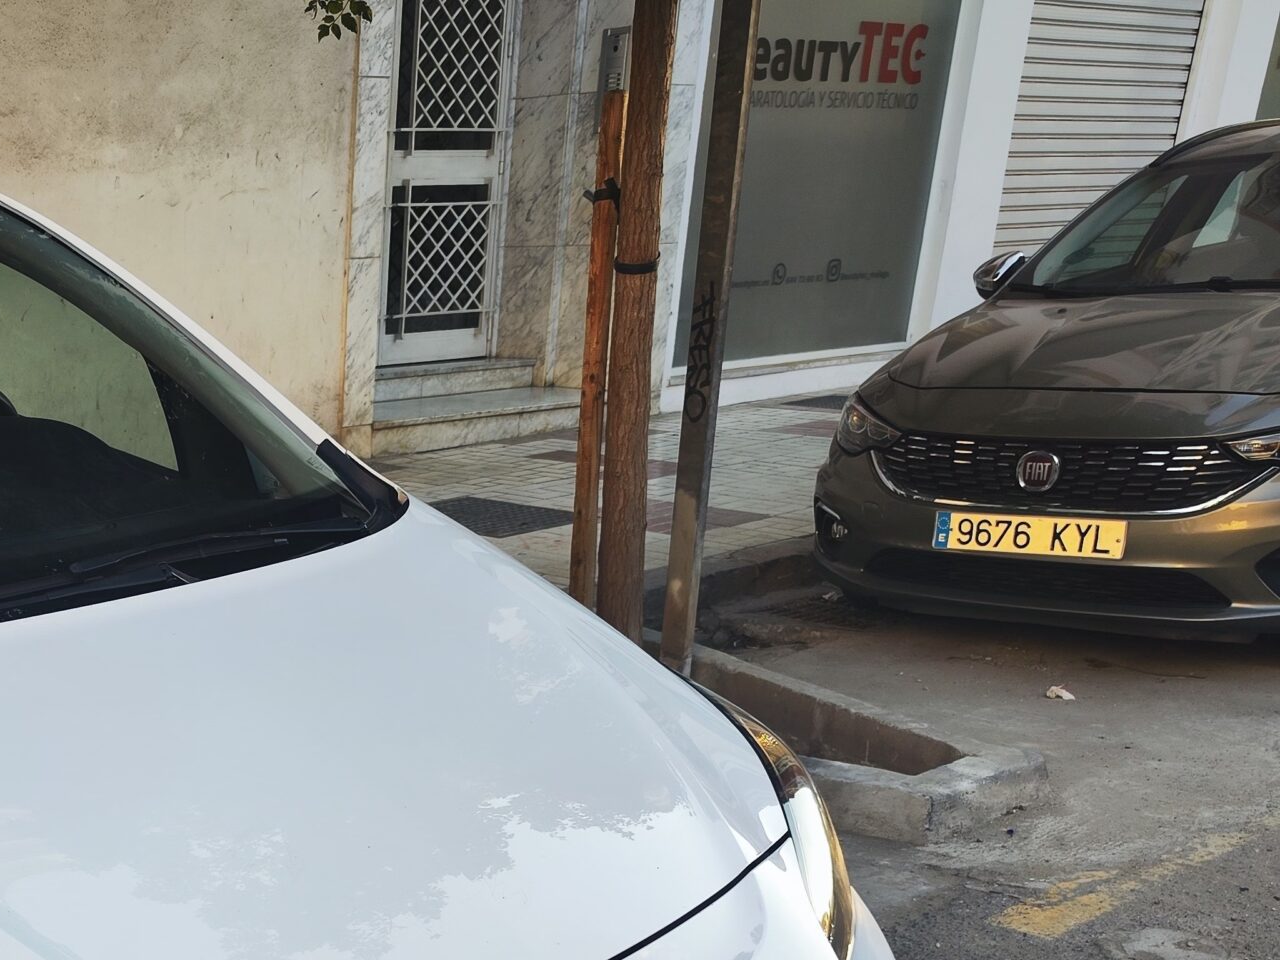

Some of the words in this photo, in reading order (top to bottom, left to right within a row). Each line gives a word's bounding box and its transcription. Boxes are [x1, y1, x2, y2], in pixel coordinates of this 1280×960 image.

[750, 88, 816, 109] ARATOLOGÍA
[818, 90, 827, 108] Y
[827, 90, 875, 110] SERVICIO
[877, 89, 919, 110] TÉCNICO
[1025, 461, 1052, 482] FIAT
[938, 533, 948, 543] E
[956, 518, 1032, 549] 9676
[1049, 522, 1111, 554] KYL
